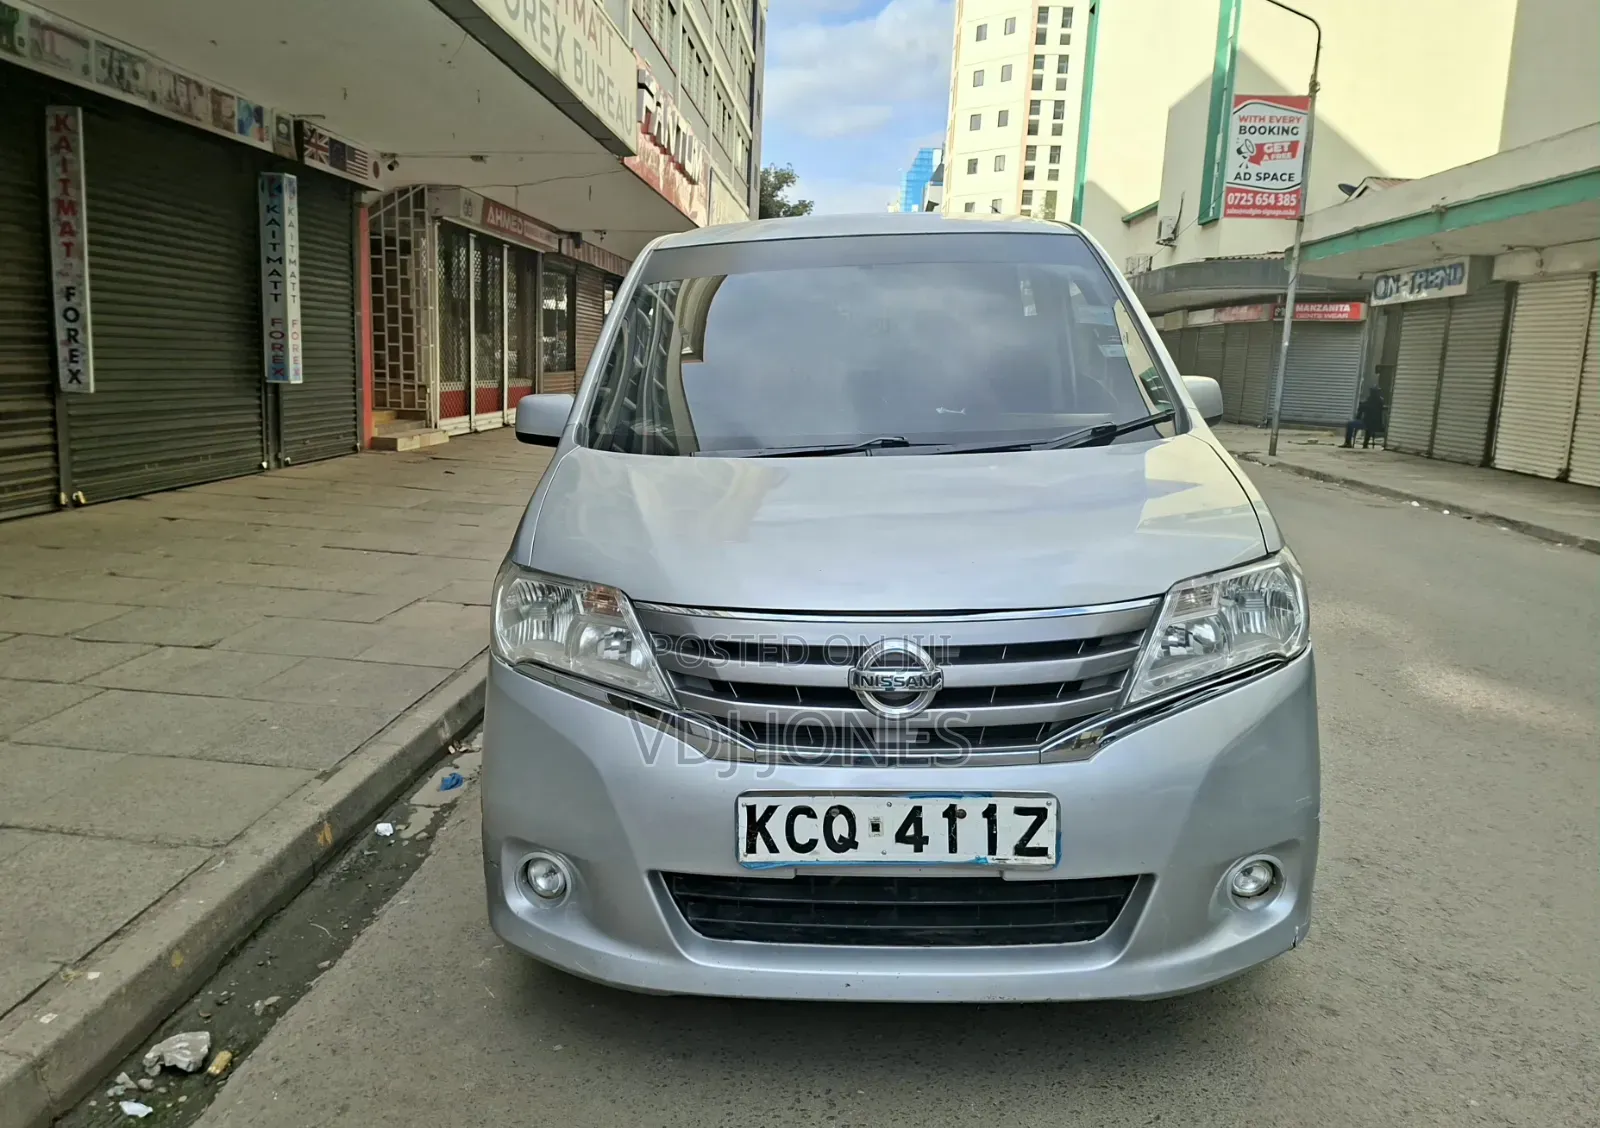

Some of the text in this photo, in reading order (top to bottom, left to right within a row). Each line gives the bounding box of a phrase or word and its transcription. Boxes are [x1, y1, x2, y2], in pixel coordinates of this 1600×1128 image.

[573, 36, 633, 136] BUREAU
[1238, 115, 1302, 124] WITH EVERY
[1238, 125, 1300, 136] BOOKING
[1263, 142, 1291, 153] GET
[1271, 152, 1293, 160] FREE
[1233, 172, 1296, 182] AD SPACE
[1227, 192, 1297, 206] 0725 654 385
[265, 204, 285, 377] KAITMATT FOREX
[287, 206, 301, 377] KAITMATT FOREX
[1296, 303, 1351, 312] MANZANITA
[62, 286, 83, 385] FOREX
[861, 675, 932, 687] NISSAN
[744, 803, 1050, 857] KCQ 411Z
